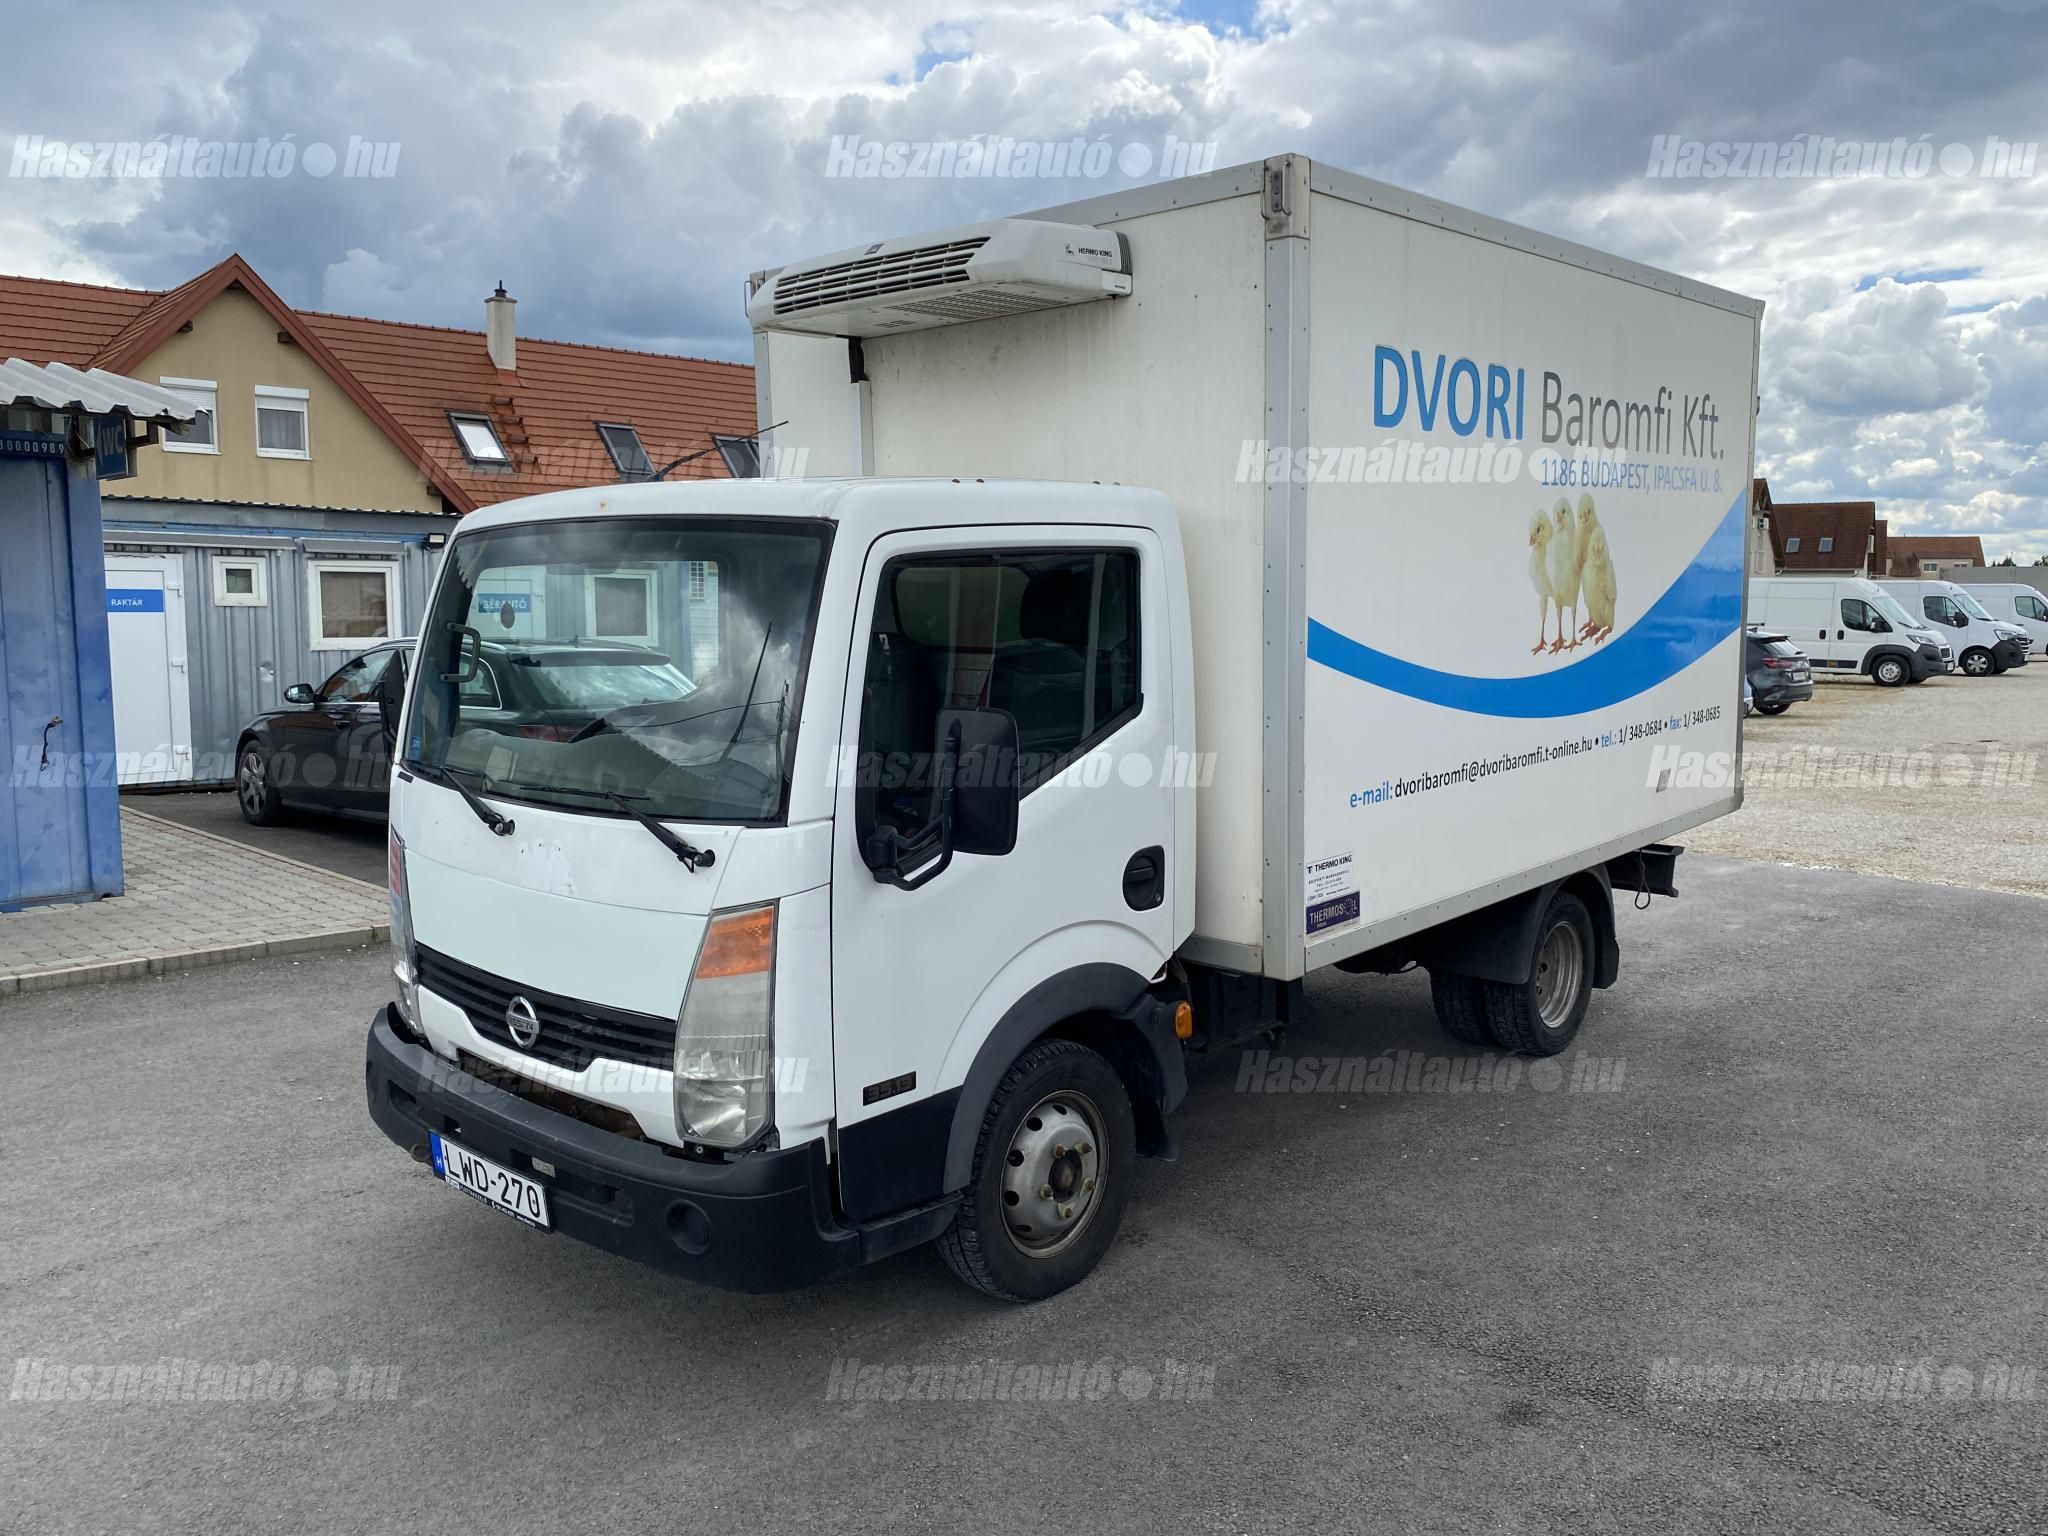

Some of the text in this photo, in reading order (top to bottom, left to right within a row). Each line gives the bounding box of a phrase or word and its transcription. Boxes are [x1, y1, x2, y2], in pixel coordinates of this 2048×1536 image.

[1374, 345, 1724, 460] DVORI Baromfi Kft.
[101, 424, 125, 456] WC
[1541, 458, 1577, 487] 1186
[1581, 459, 1651, 495] BUDAPEST,
[1653, 464, 1698, 493] IPACSFA
[1713, 469, 1724, 493] 8.
[111, 597, 143, 607] RAKTÁR
[1350, 781, 1394, 808] e-mail:
[1394, 737, 1593, 798] dvoribaromfi@dvoribaromfi.t-online.hu
[1601, 732, 1618, 749] tel.:
[1629, 719, 1663, 742] 348-0684
[1669, 714, 1683, 731] fax:
[1692, 706, 1721, 726] 348-0685
[1315, 858, 1339, 872] THERMO
[1339, 854, 1352, 865] KING
[444, 1143, 541, 1218] LWD-270
